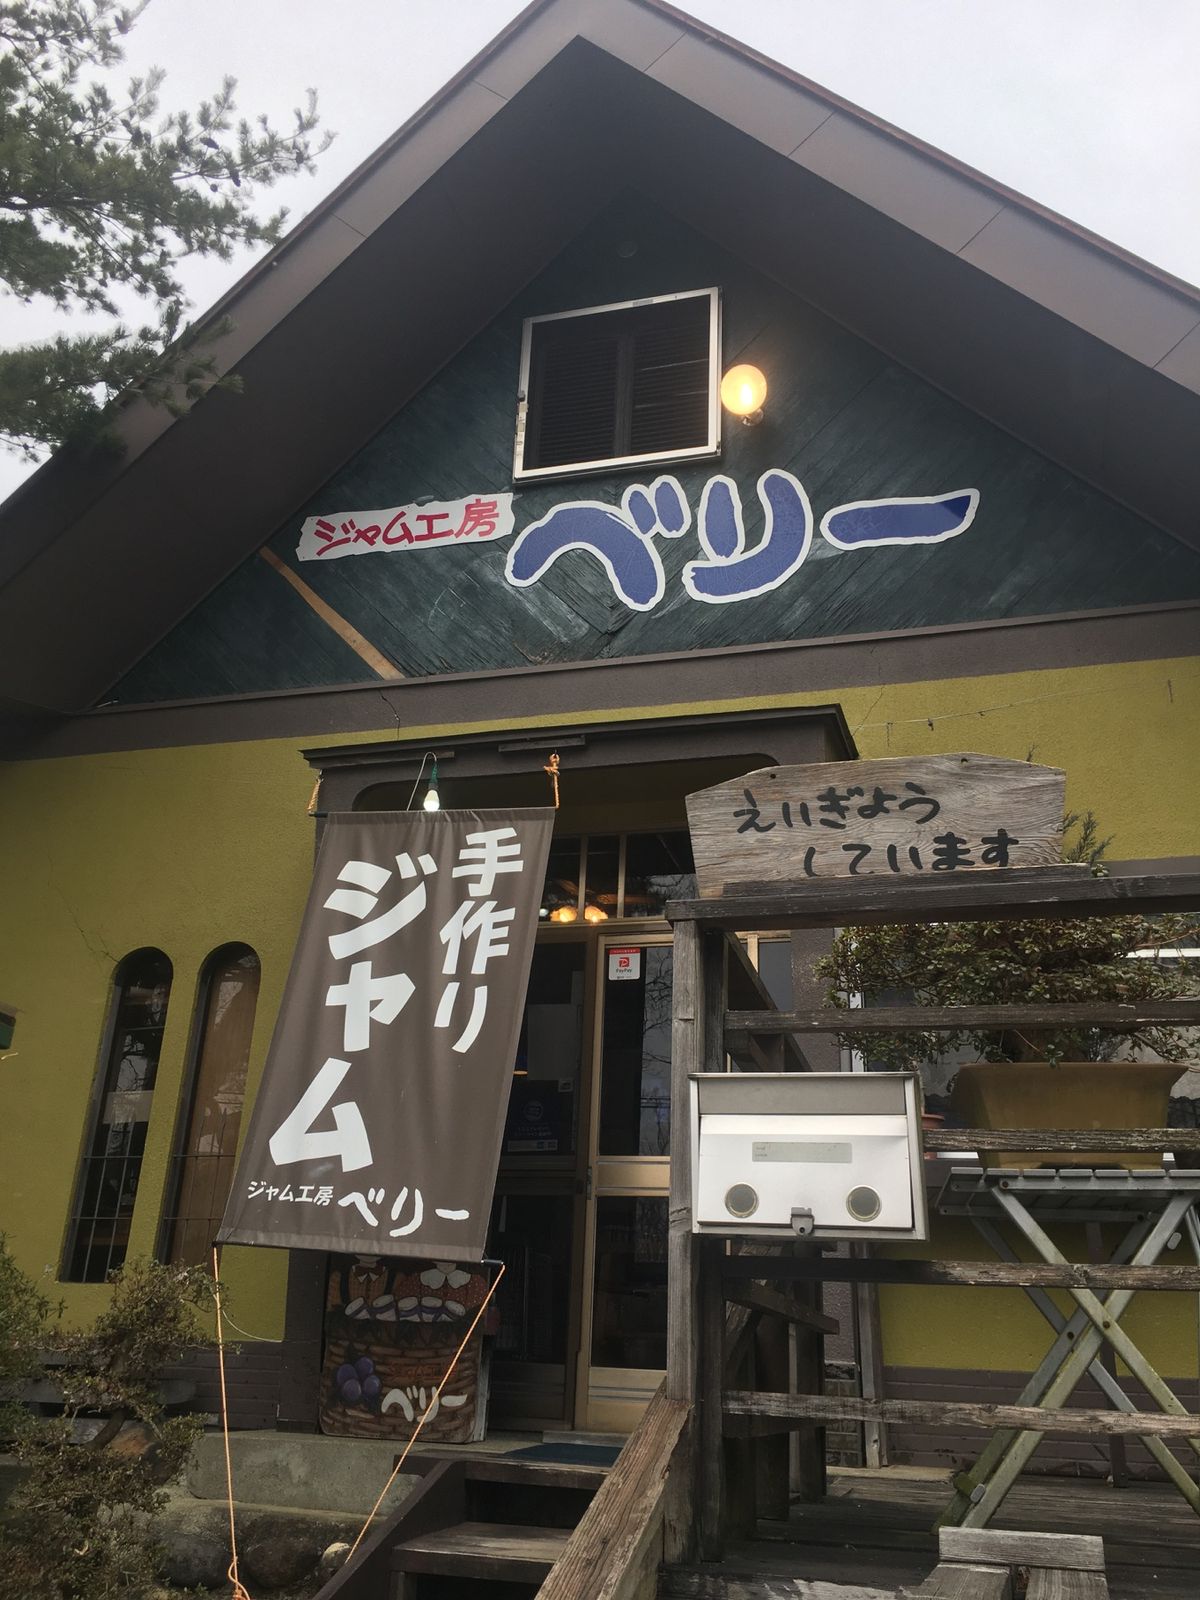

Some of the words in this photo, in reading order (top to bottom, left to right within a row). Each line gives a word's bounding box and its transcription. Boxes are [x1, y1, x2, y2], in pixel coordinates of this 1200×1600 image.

[314, 498, 499, 556] ジャム工房
[506, 469, 979, 612] ベリー
[804, 829, 1019, 877] しています
[434, 827, 524, 1053] 手作り
[269, 852, 438, 1172] ジャム
[248, 1181, 334, 1206] ジャム工房
[338, 1187, 470, 1237] ベリー
[381, 1385, 467, 1422] ベリー
